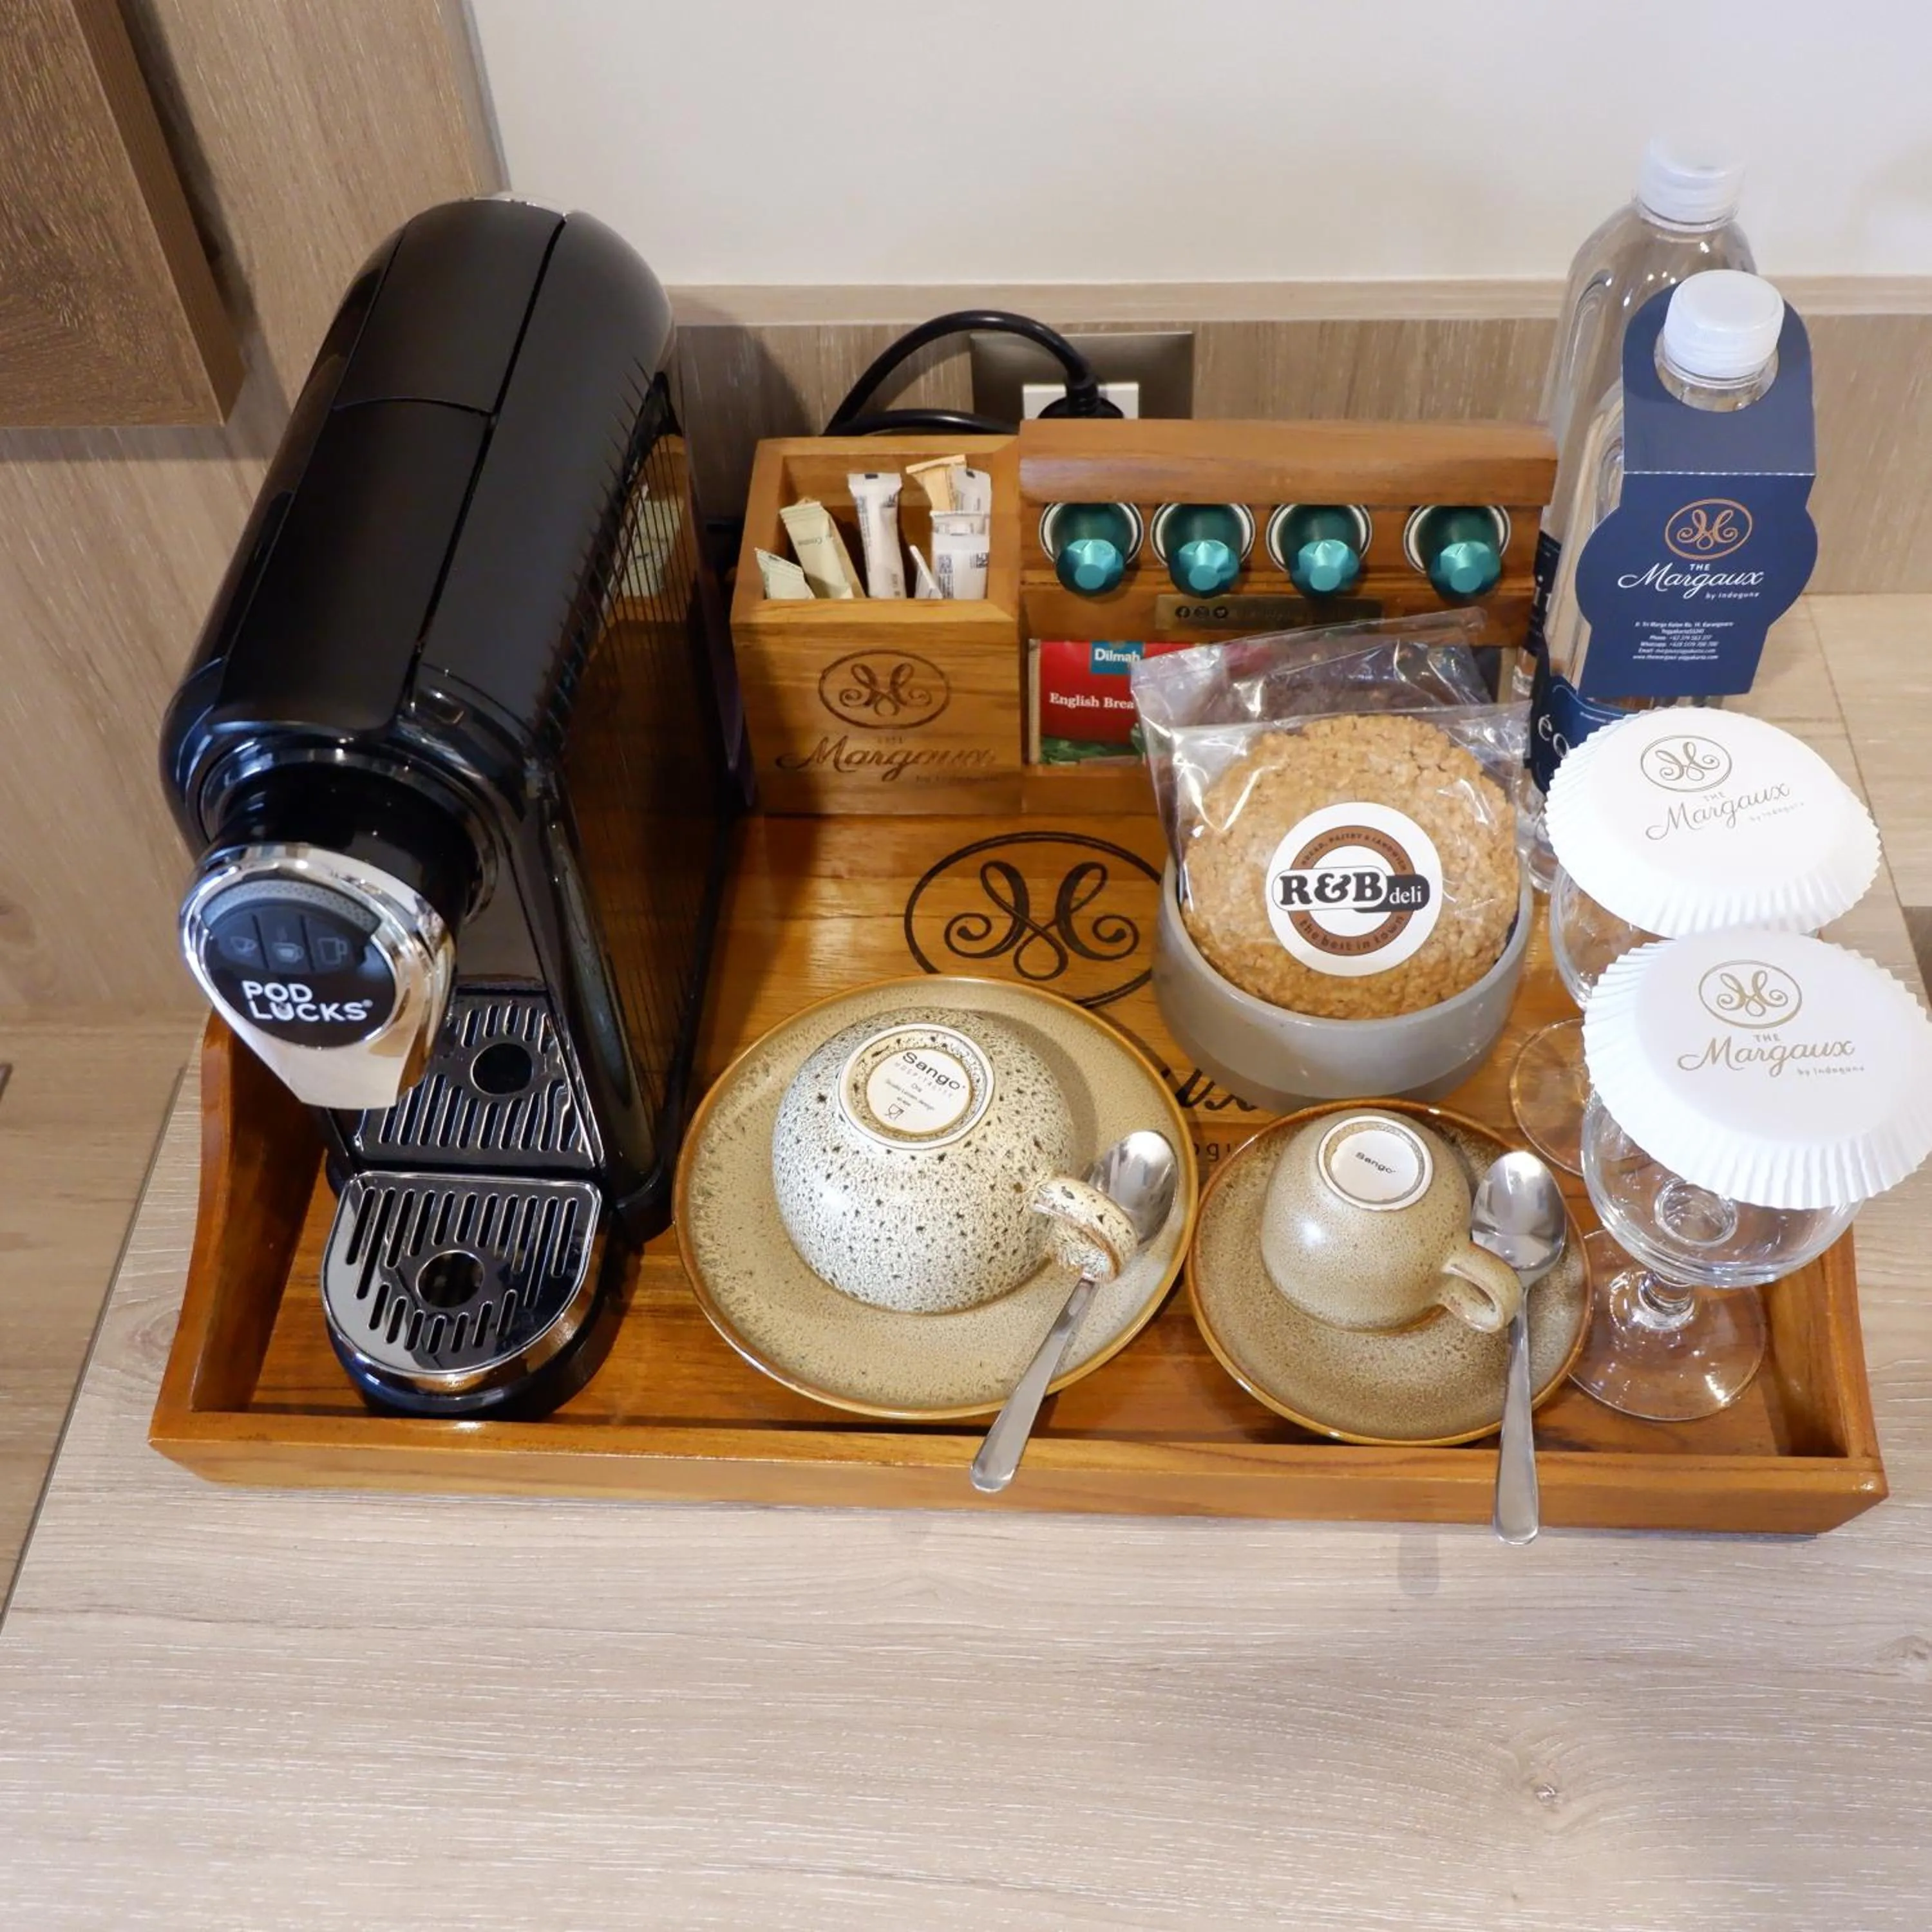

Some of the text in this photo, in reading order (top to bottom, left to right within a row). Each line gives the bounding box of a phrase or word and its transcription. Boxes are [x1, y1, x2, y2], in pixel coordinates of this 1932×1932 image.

[1617, 562, 1765, 600] Margaux
[1095, 647, 1141, 663] Dilmah
[1049, 692, 1099, 708] English
[775, 735, 996, 782] Margaux
[1645, 783, 1790, 840] Margaux
[1280, 872, 1422, 905] R&B deli
[1300, 916, 1405, 951] the best in town
[241, 980, 314, 1003] POD
[1753, 1034, 1781, 1042] THE
[903, 1052, 960, 1090] Sango
[1677, 1036, 1855, 1077] Margaux
[1355, 1151, 1392, 1173] Sango
